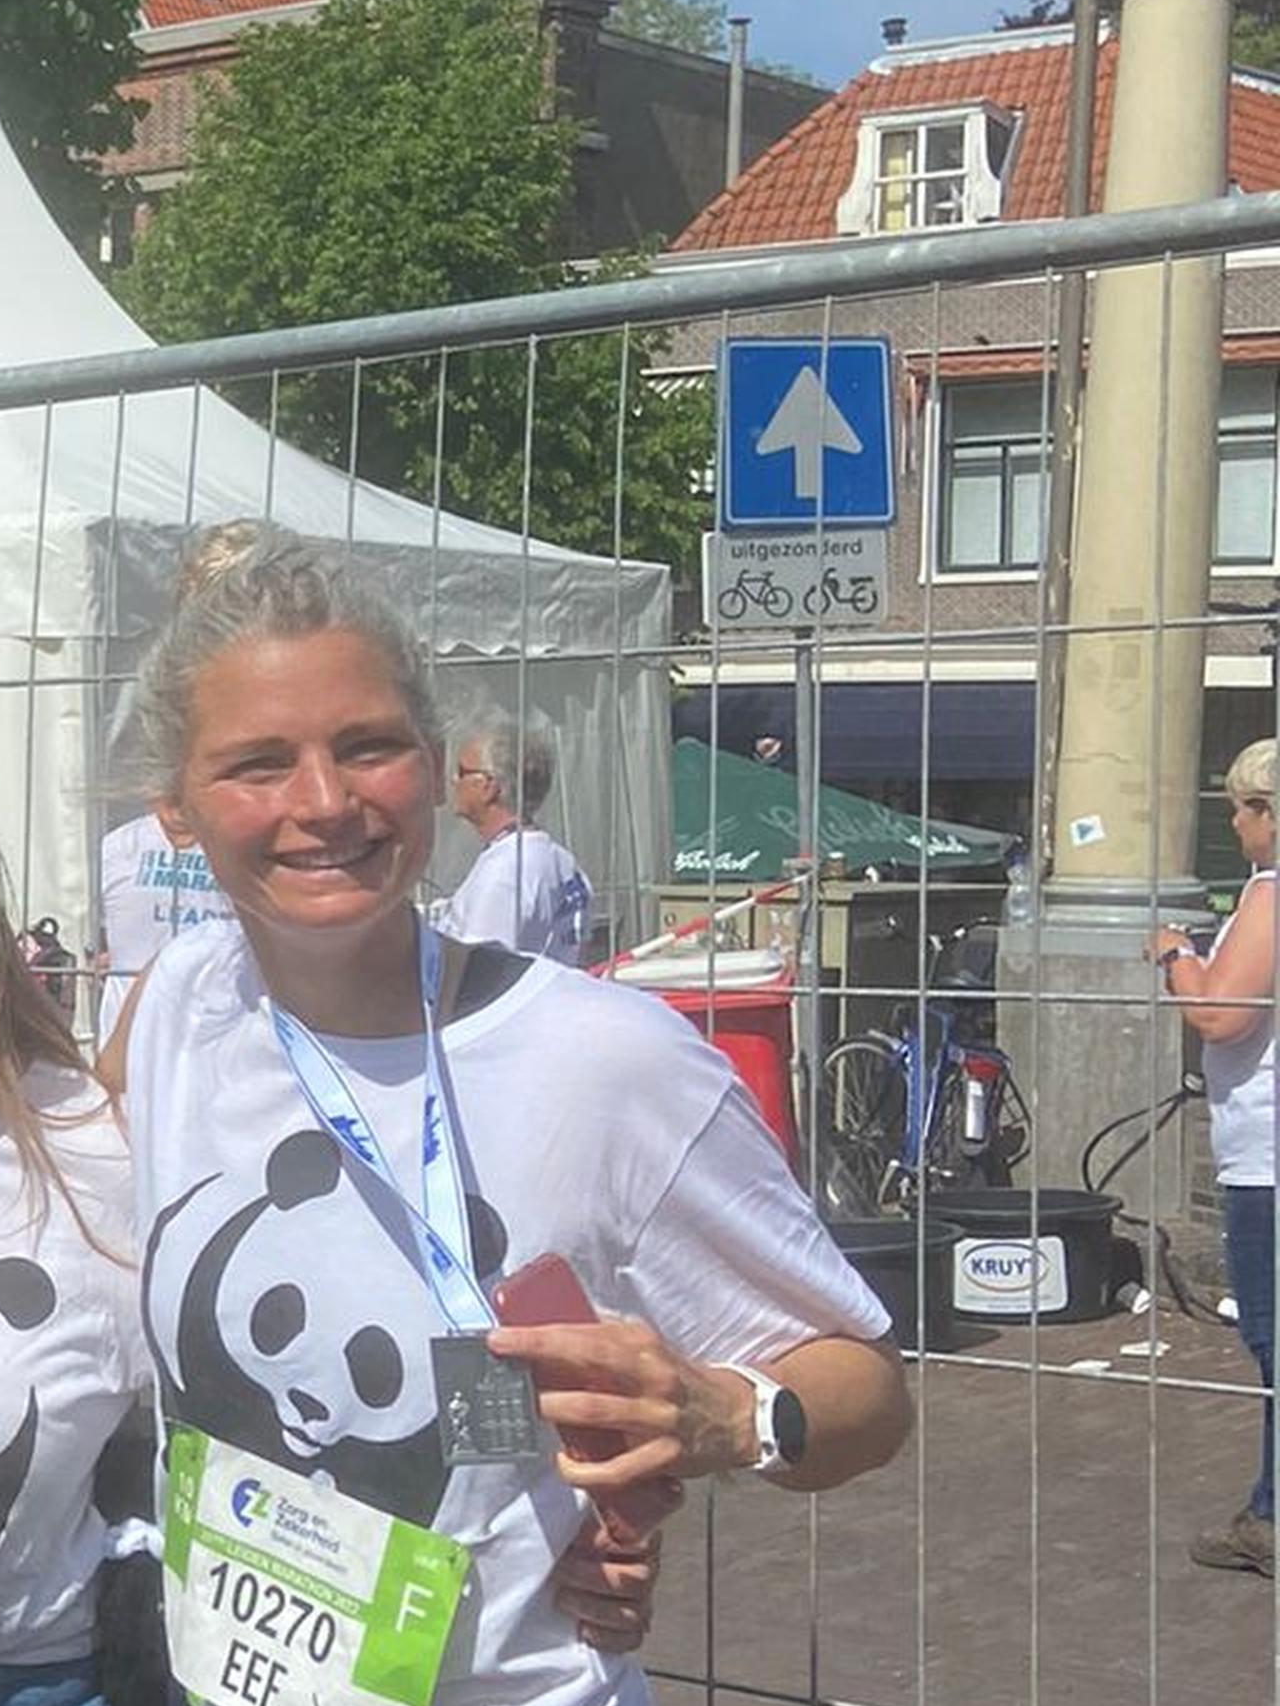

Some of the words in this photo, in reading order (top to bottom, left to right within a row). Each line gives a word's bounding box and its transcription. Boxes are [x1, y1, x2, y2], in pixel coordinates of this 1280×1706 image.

[274, 1512, 341, 1554] Zekerheid
[276, 1497, 309, 1524] Zorg
[208, 1561, 336, 1664] 10270
[394, 1581, 435, 1634] F
